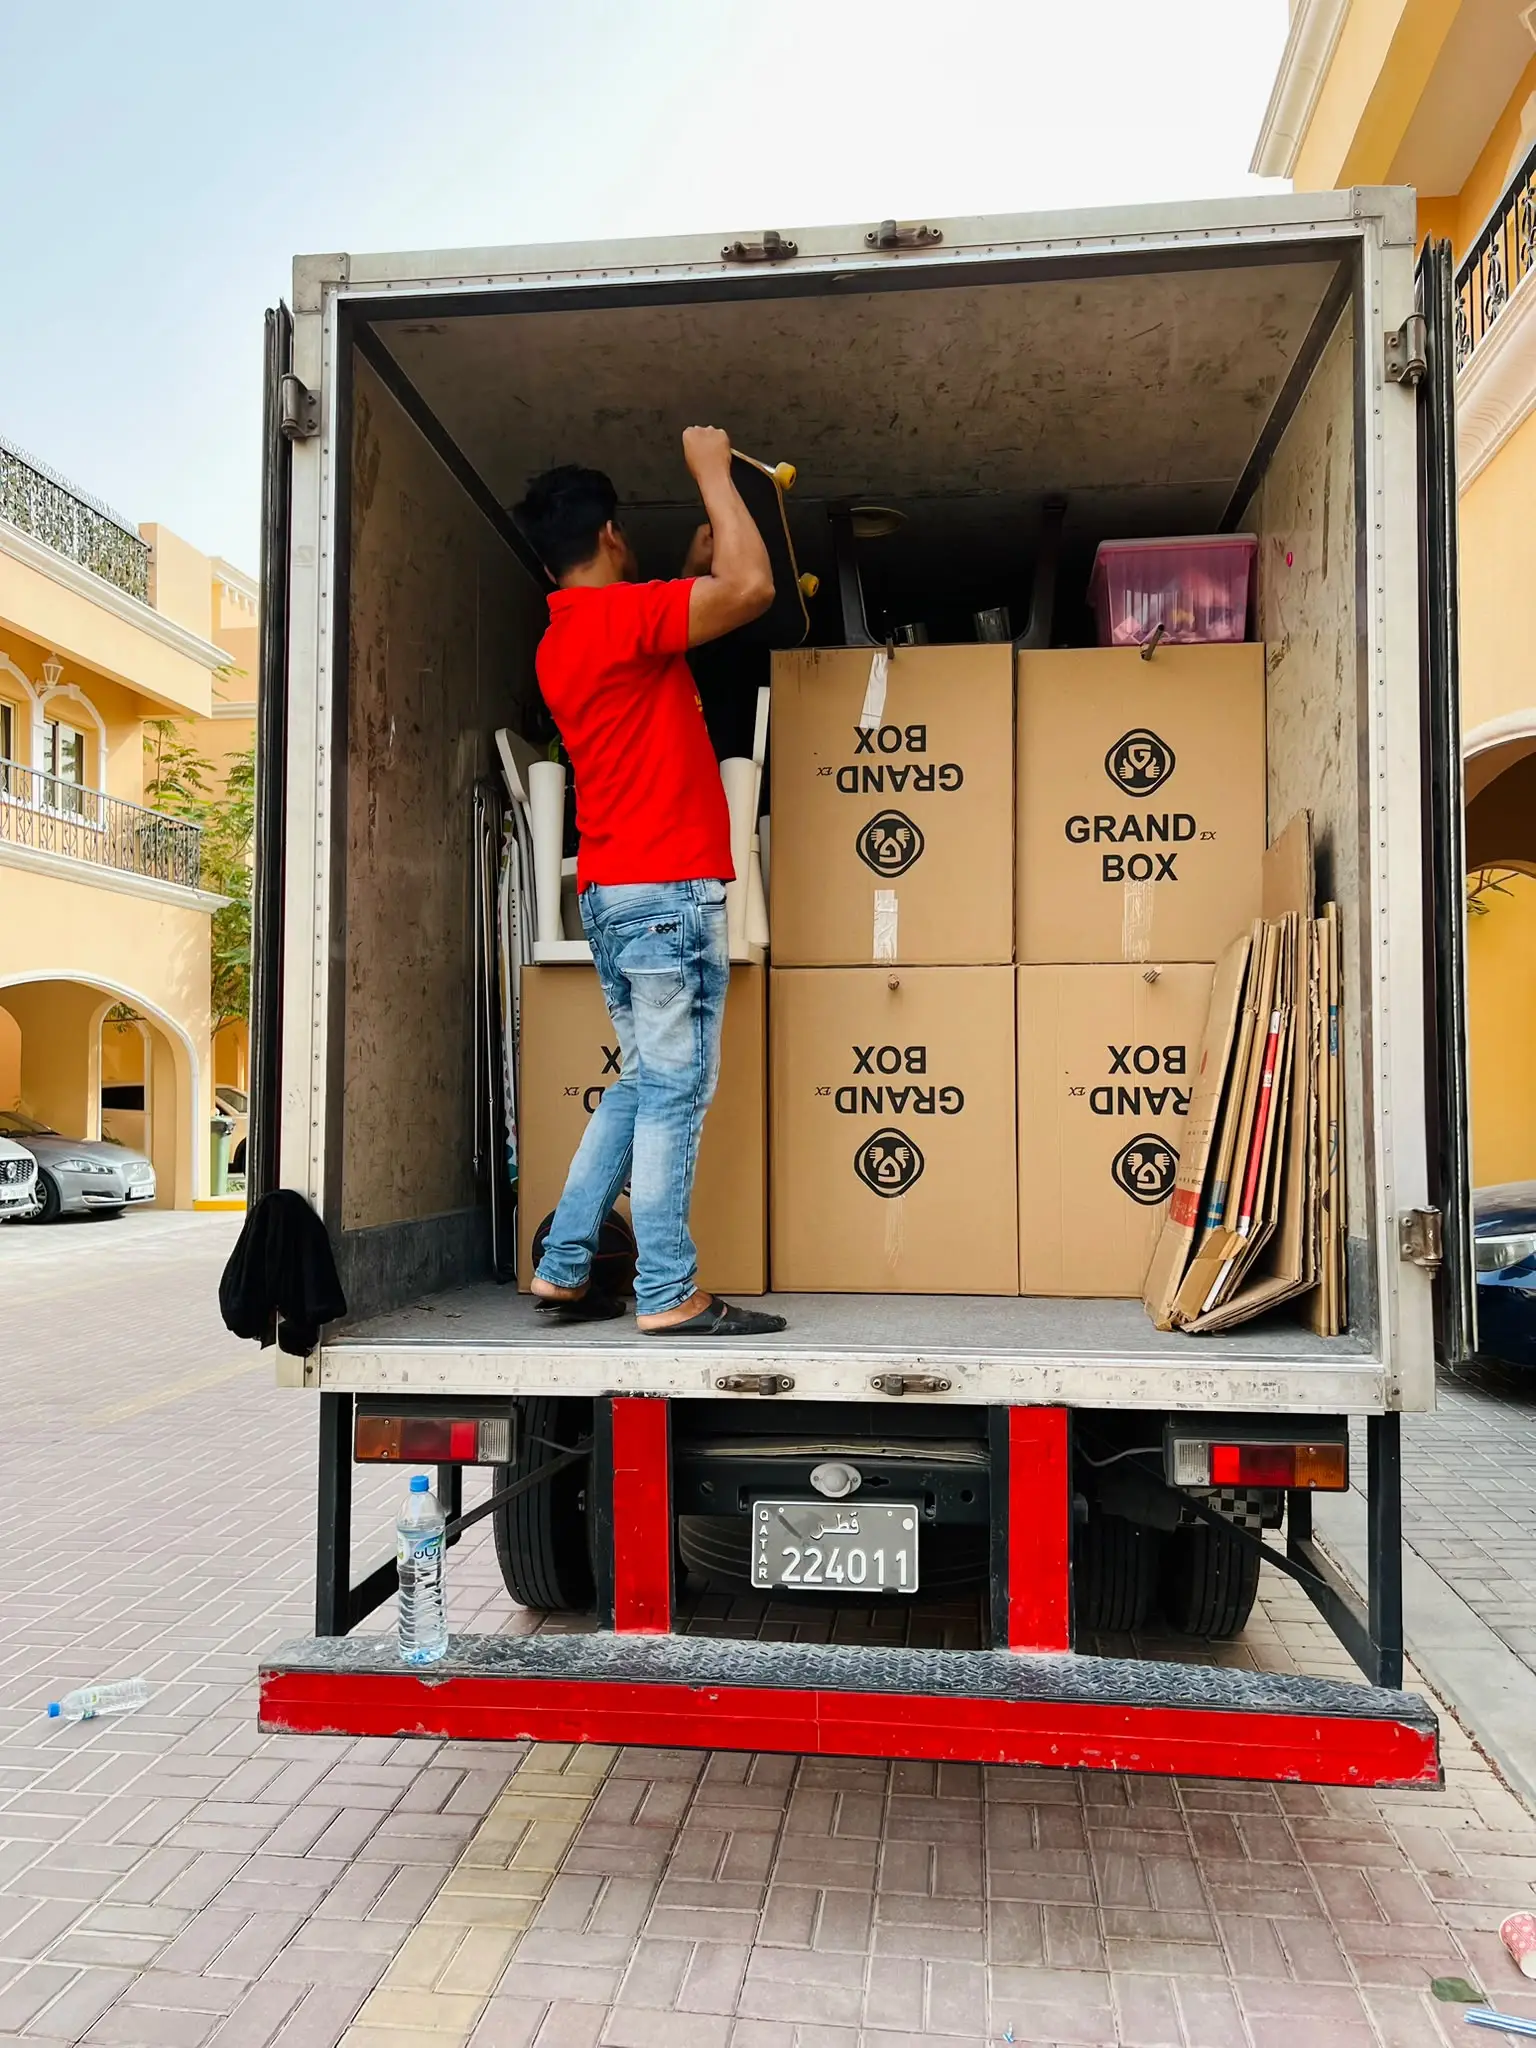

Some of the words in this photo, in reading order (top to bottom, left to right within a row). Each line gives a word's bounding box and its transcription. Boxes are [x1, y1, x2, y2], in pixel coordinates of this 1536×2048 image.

[853, 724, 927, 754] BOX
[836, 763, 964, 794] GRAND
[1064, 813, 1196, 844] GRAND
[1102, 852, 1179, 883] BOX
[851, 1045, 927, 1075] BOX
[1107, 1045, 1186, 1075] BOX
[834, 1085, 965, 1115] GRAND
[1088, 1085, 1194, 1116] RAND
[810, 1511, 861, 1541] قطر
[758, 1510, 770, 1580] QATAR
[781, 1547, 908, 1586] 224011
